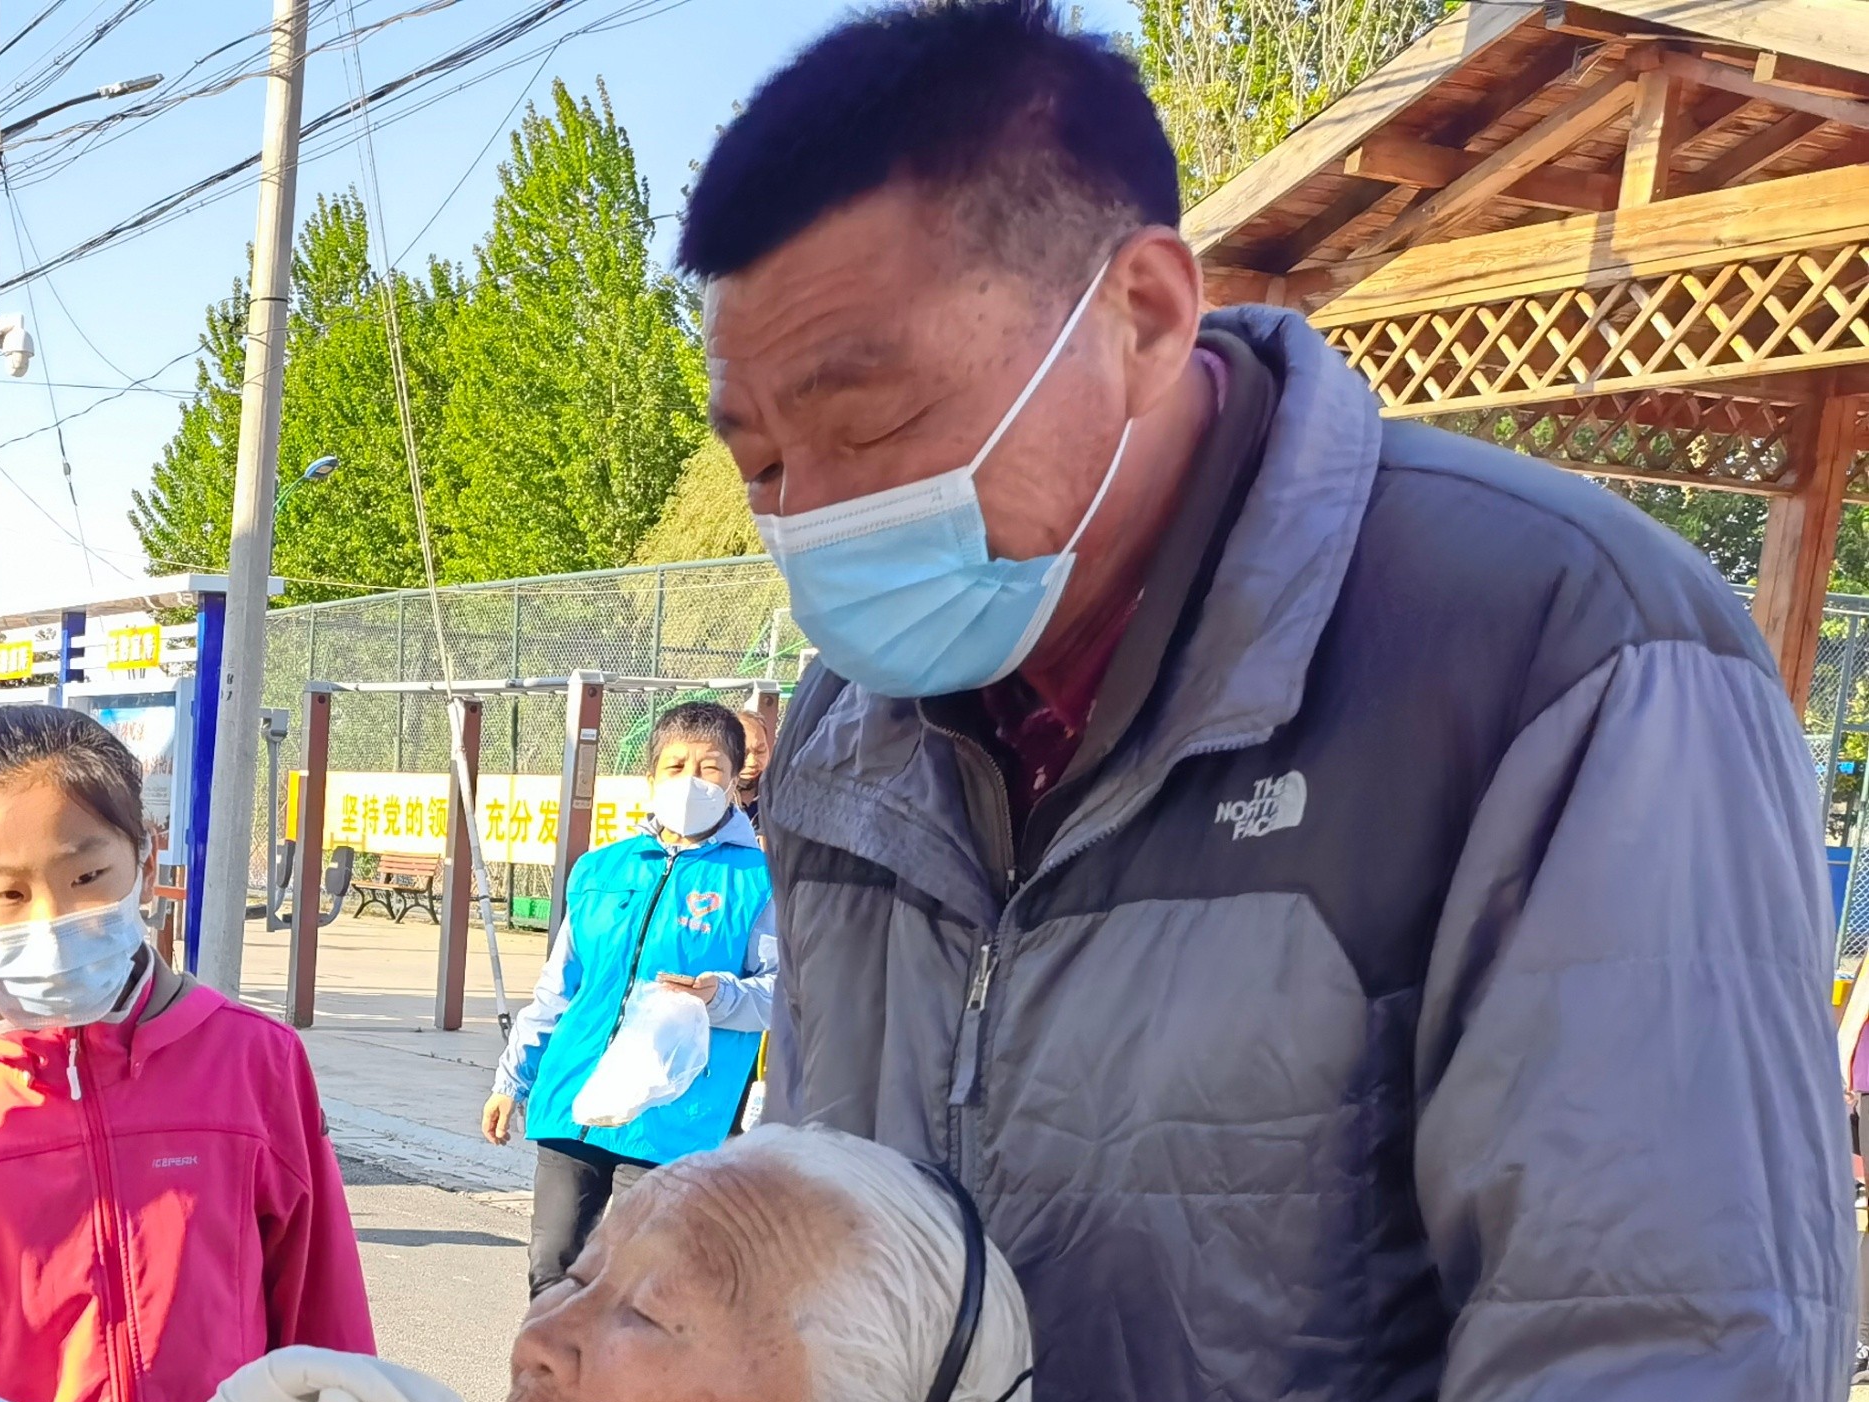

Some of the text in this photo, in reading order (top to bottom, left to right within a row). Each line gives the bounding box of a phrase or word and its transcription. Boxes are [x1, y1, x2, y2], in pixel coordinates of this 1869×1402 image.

[341, 794, 448, 838] 坚持党的领
[485, 798, 559, 844] 充分发
